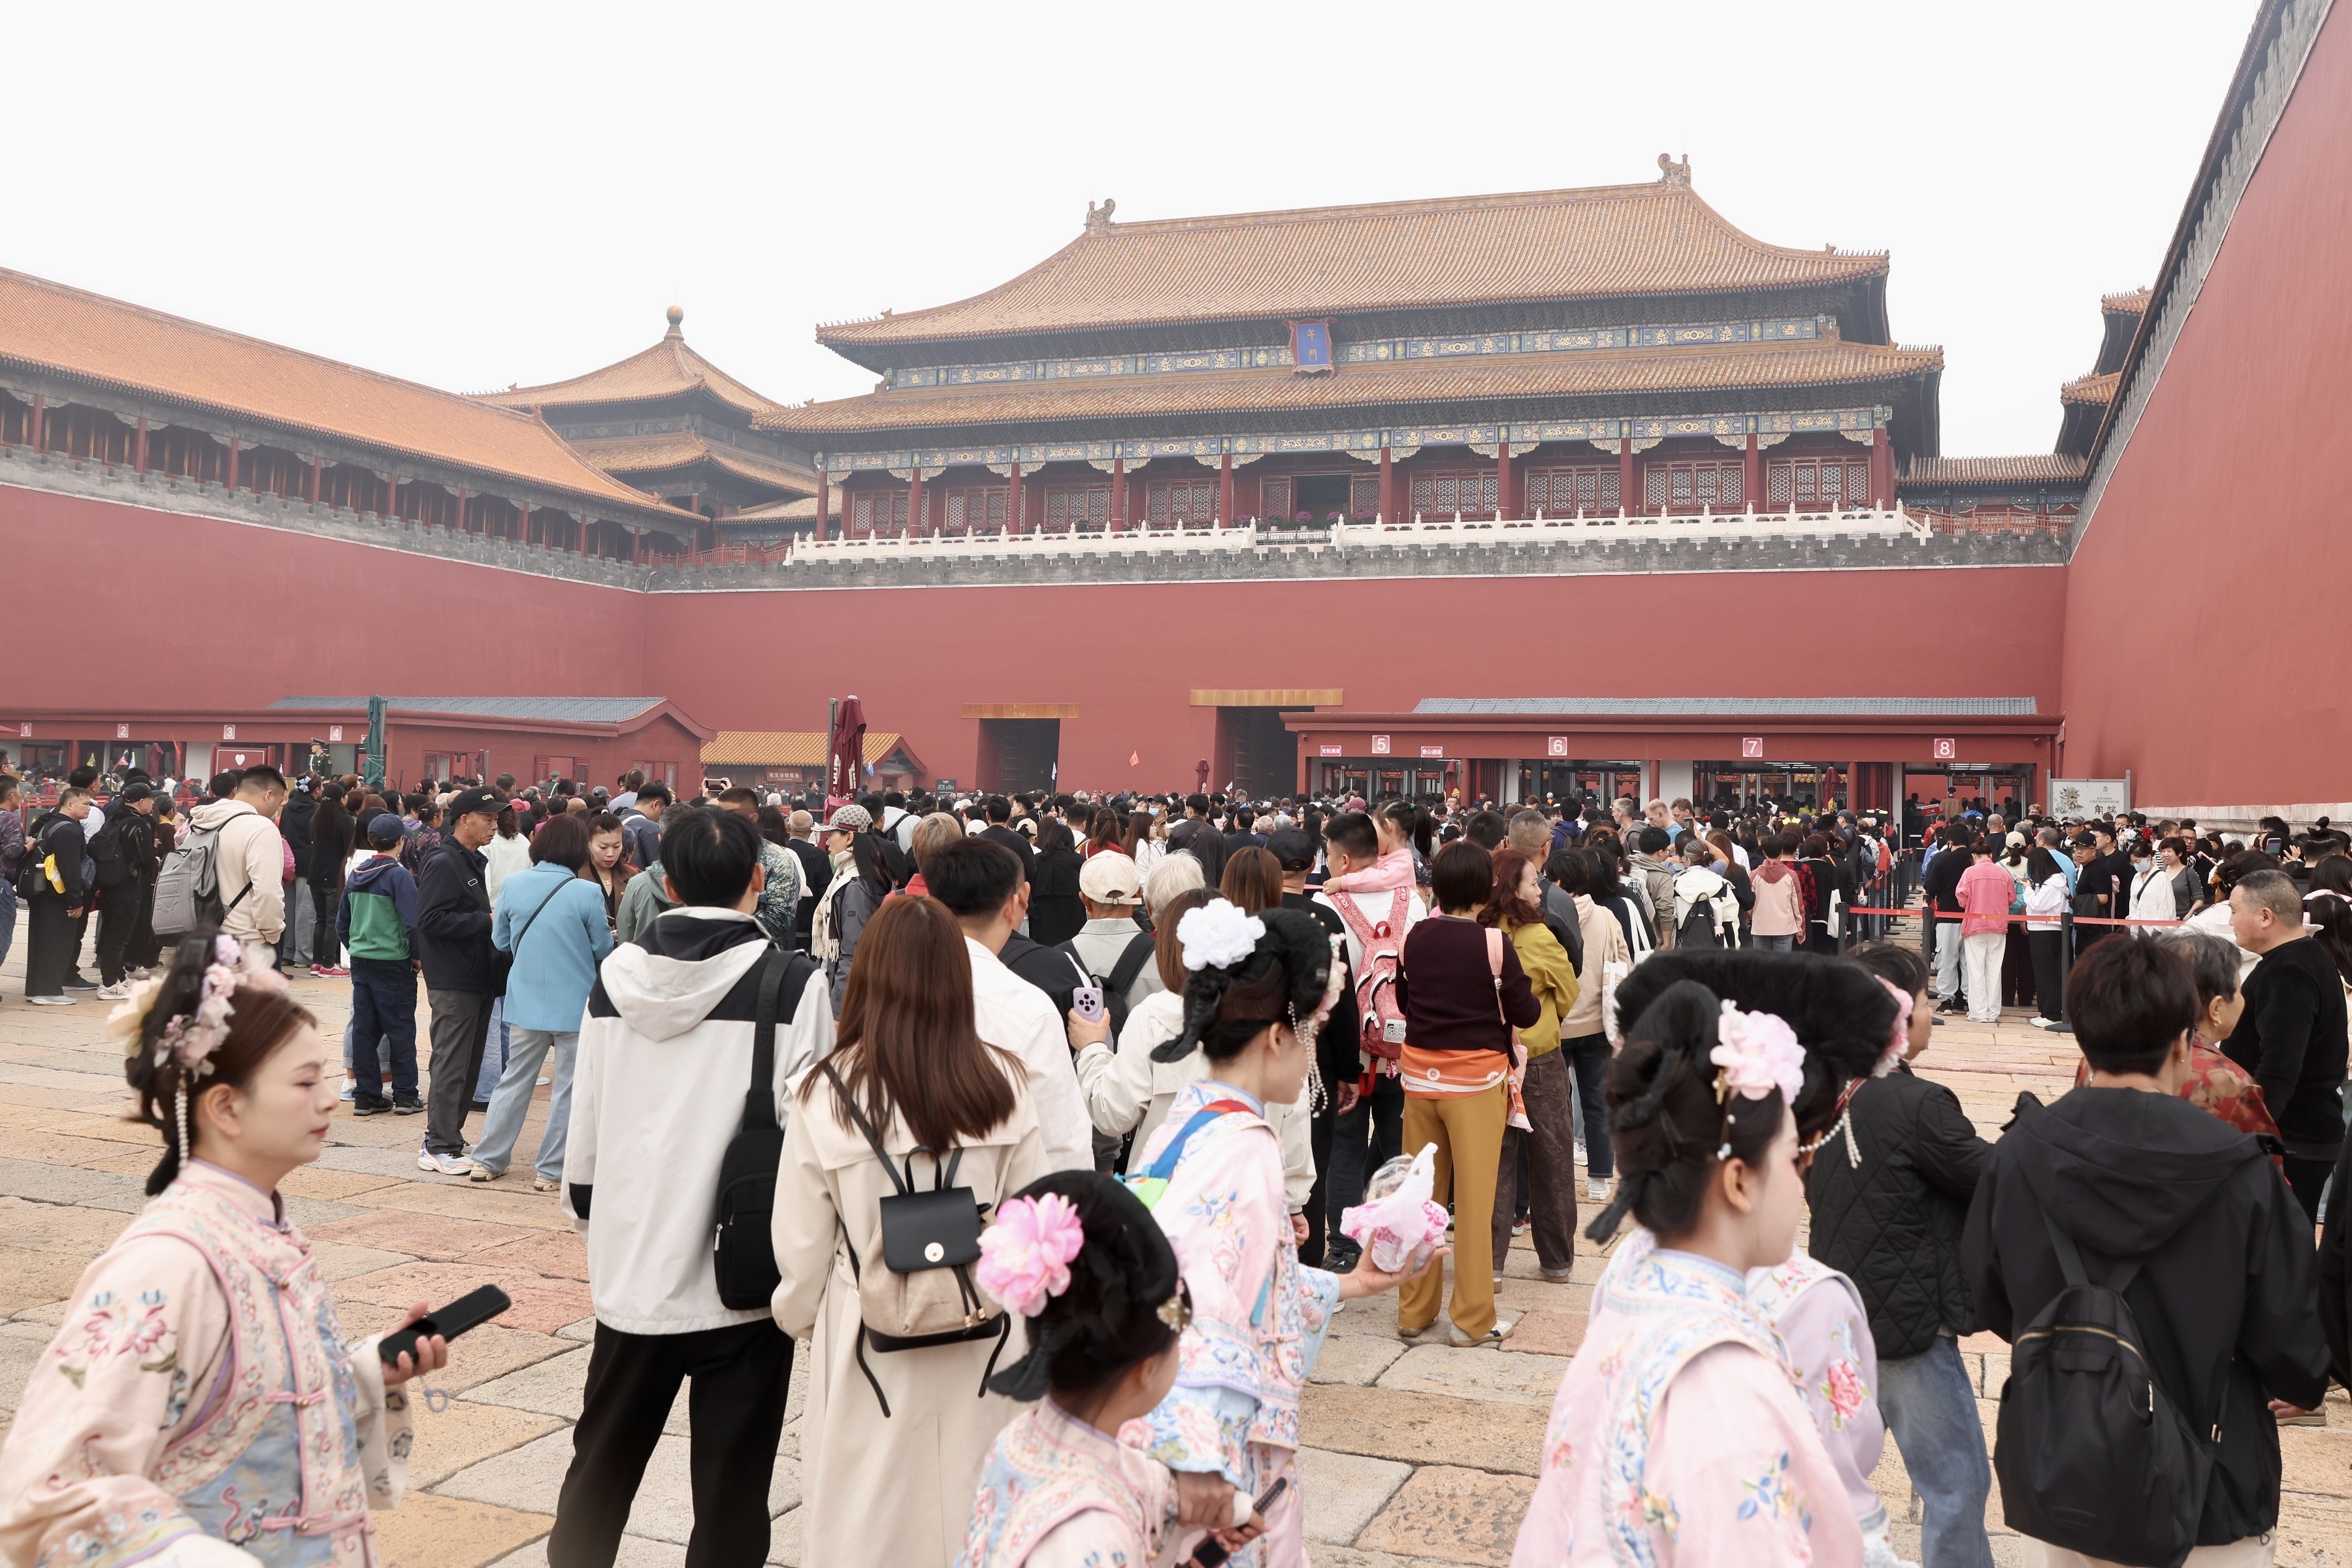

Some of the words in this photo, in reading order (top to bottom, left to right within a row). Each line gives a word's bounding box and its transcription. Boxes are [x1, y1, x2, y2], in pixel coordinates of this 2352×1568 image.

[1307, 328, 1317, 361] 午門
[120, 726, 126, 736] 2
[226, 727, 233, 737] 3
[333, 728, 340, 738] 4
[1377, 738, 1386, 751] 5
[1553, 739, 1563, 753] 6
[1748, 740, 1758, 754] 7
[1940, 742, 1950, 755] 8
